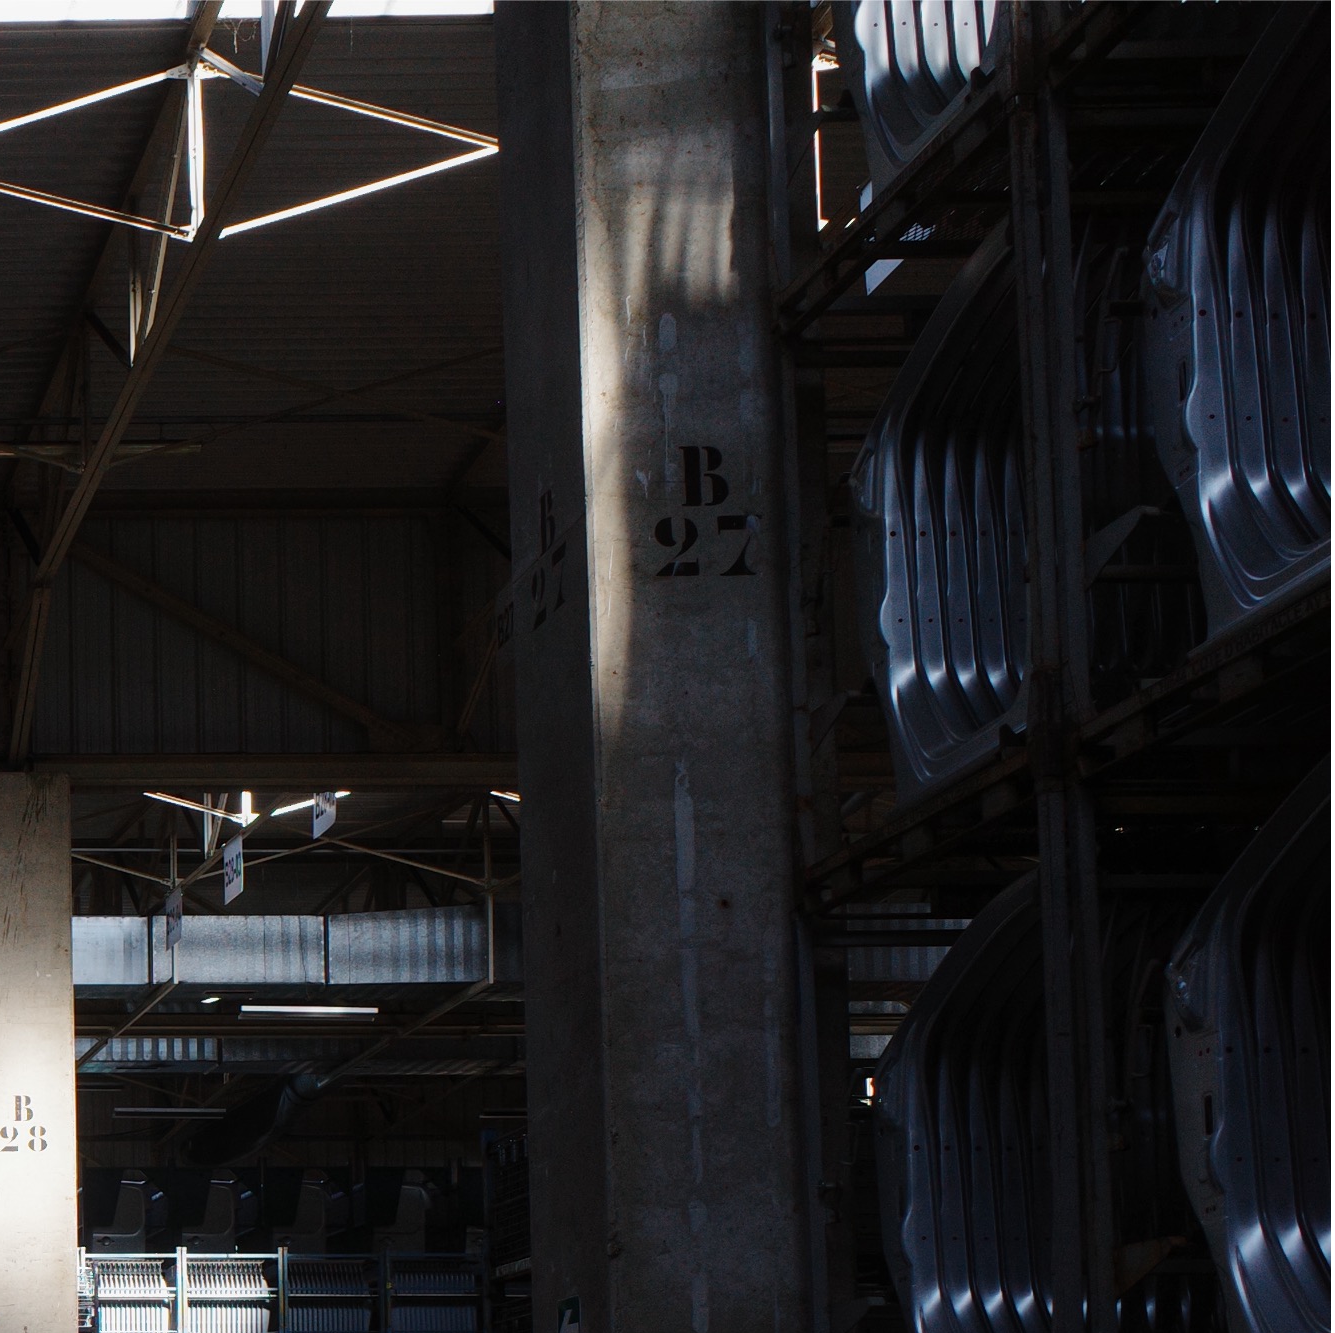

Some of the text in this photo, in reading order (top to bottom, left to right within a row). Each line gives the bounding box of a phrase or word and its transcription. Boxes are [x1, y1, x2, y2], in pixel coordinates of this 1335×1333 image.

[679, 445, 729, 507] B
[653, 514, 762, 577] 27
[13, 1095, 34, 1121] B
[0, 1125, 48, 1153] 28
